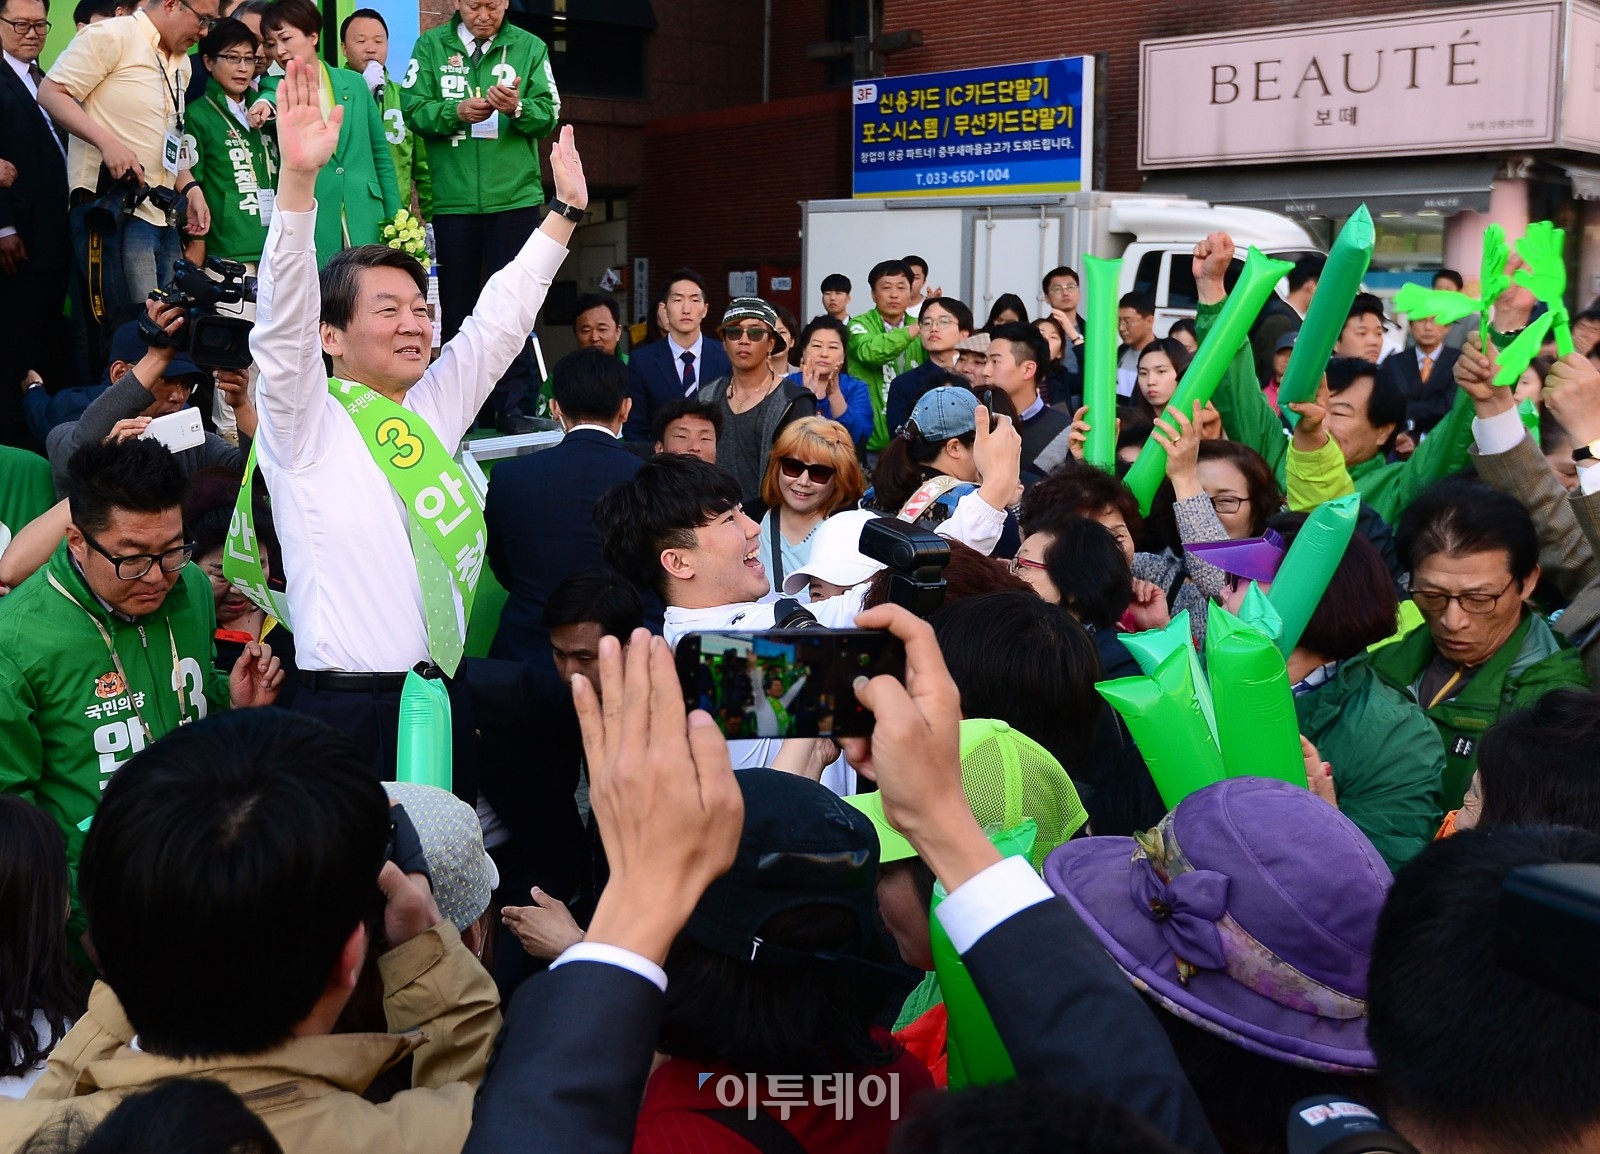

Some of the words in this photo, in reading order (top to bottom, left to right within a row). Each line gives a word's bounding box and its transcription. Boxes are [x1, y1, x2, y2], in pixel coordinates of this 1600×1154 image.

[401, 58, 420, 89] 3
[1209, 29, 1480, 105] BEAUTÉ
[857, 87, 873, 101] 3F
[879, 87, 941, 115] 신용카드
[944, 76, 1050, 107] IC카드단말기
[383, 108, 406, 145] 3
[861, 116, 939, 144] 포스시스템
[953, 106, 1074, 138] 무선카드단말기
[1313, 106, 1358, 127] 보떼
[860, 151, 886, 164] 창업의
[887, 150, 904, 162] 성공
[1013, 137, 1075, 152] 도와드립니다.
[915, 168, 1010, 186] T.033-650-1004
[375, 416, 425, 470] 3
[84, 691, 146, 720] 국민의당
[171, 656, 208, 727] 3
